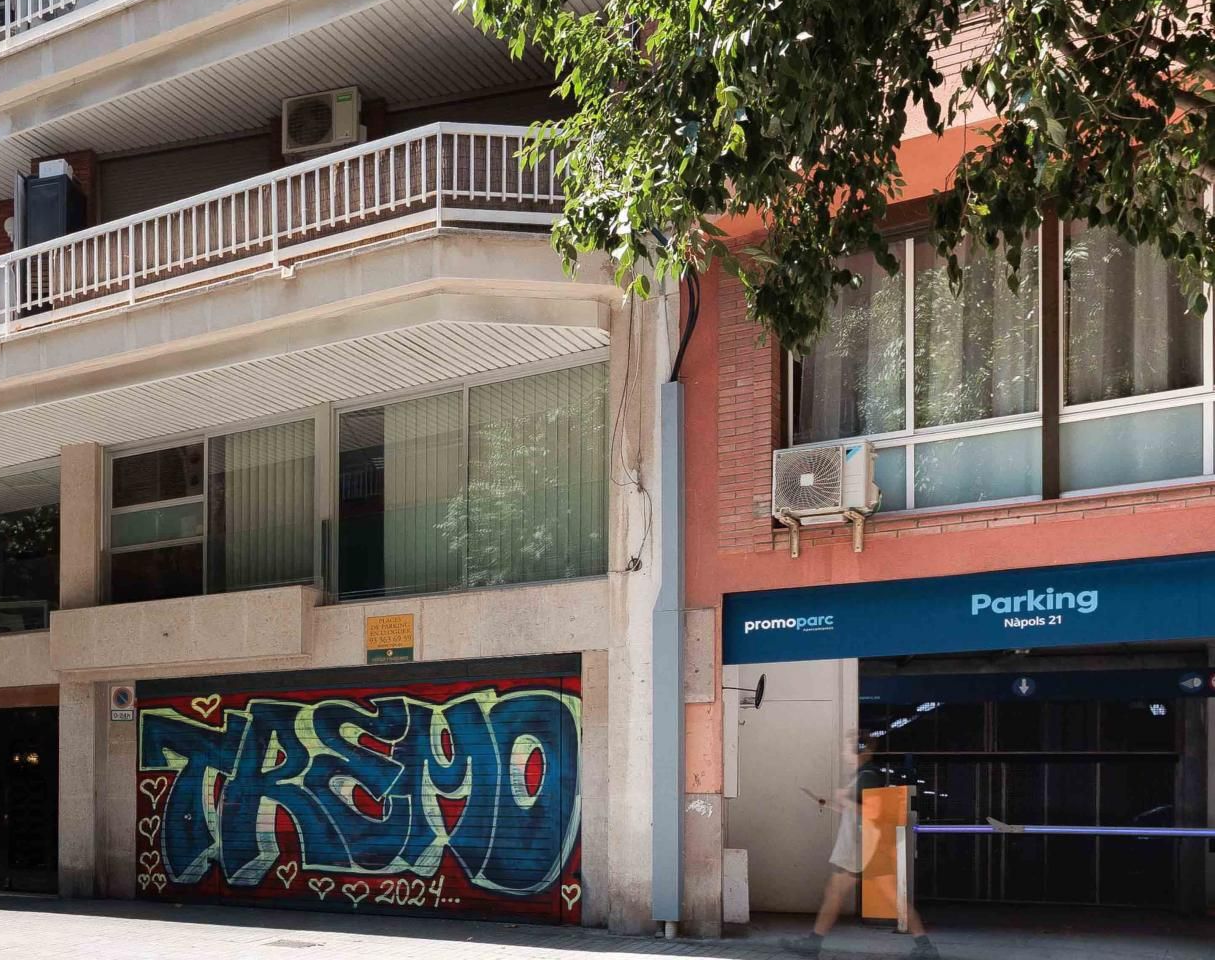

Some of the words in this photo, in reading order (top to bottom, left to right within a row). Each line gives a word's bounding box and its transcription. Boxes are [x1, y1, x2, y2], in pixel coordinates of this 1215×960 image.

[971, 587, 1098, 616] Parking
[744, 615, 834, 634] promoparc
[1004, 616, 1045, 629] Nàpols
[1048, 615, 1062, 625] 21
[139, 689, 581, 895] TREMO
